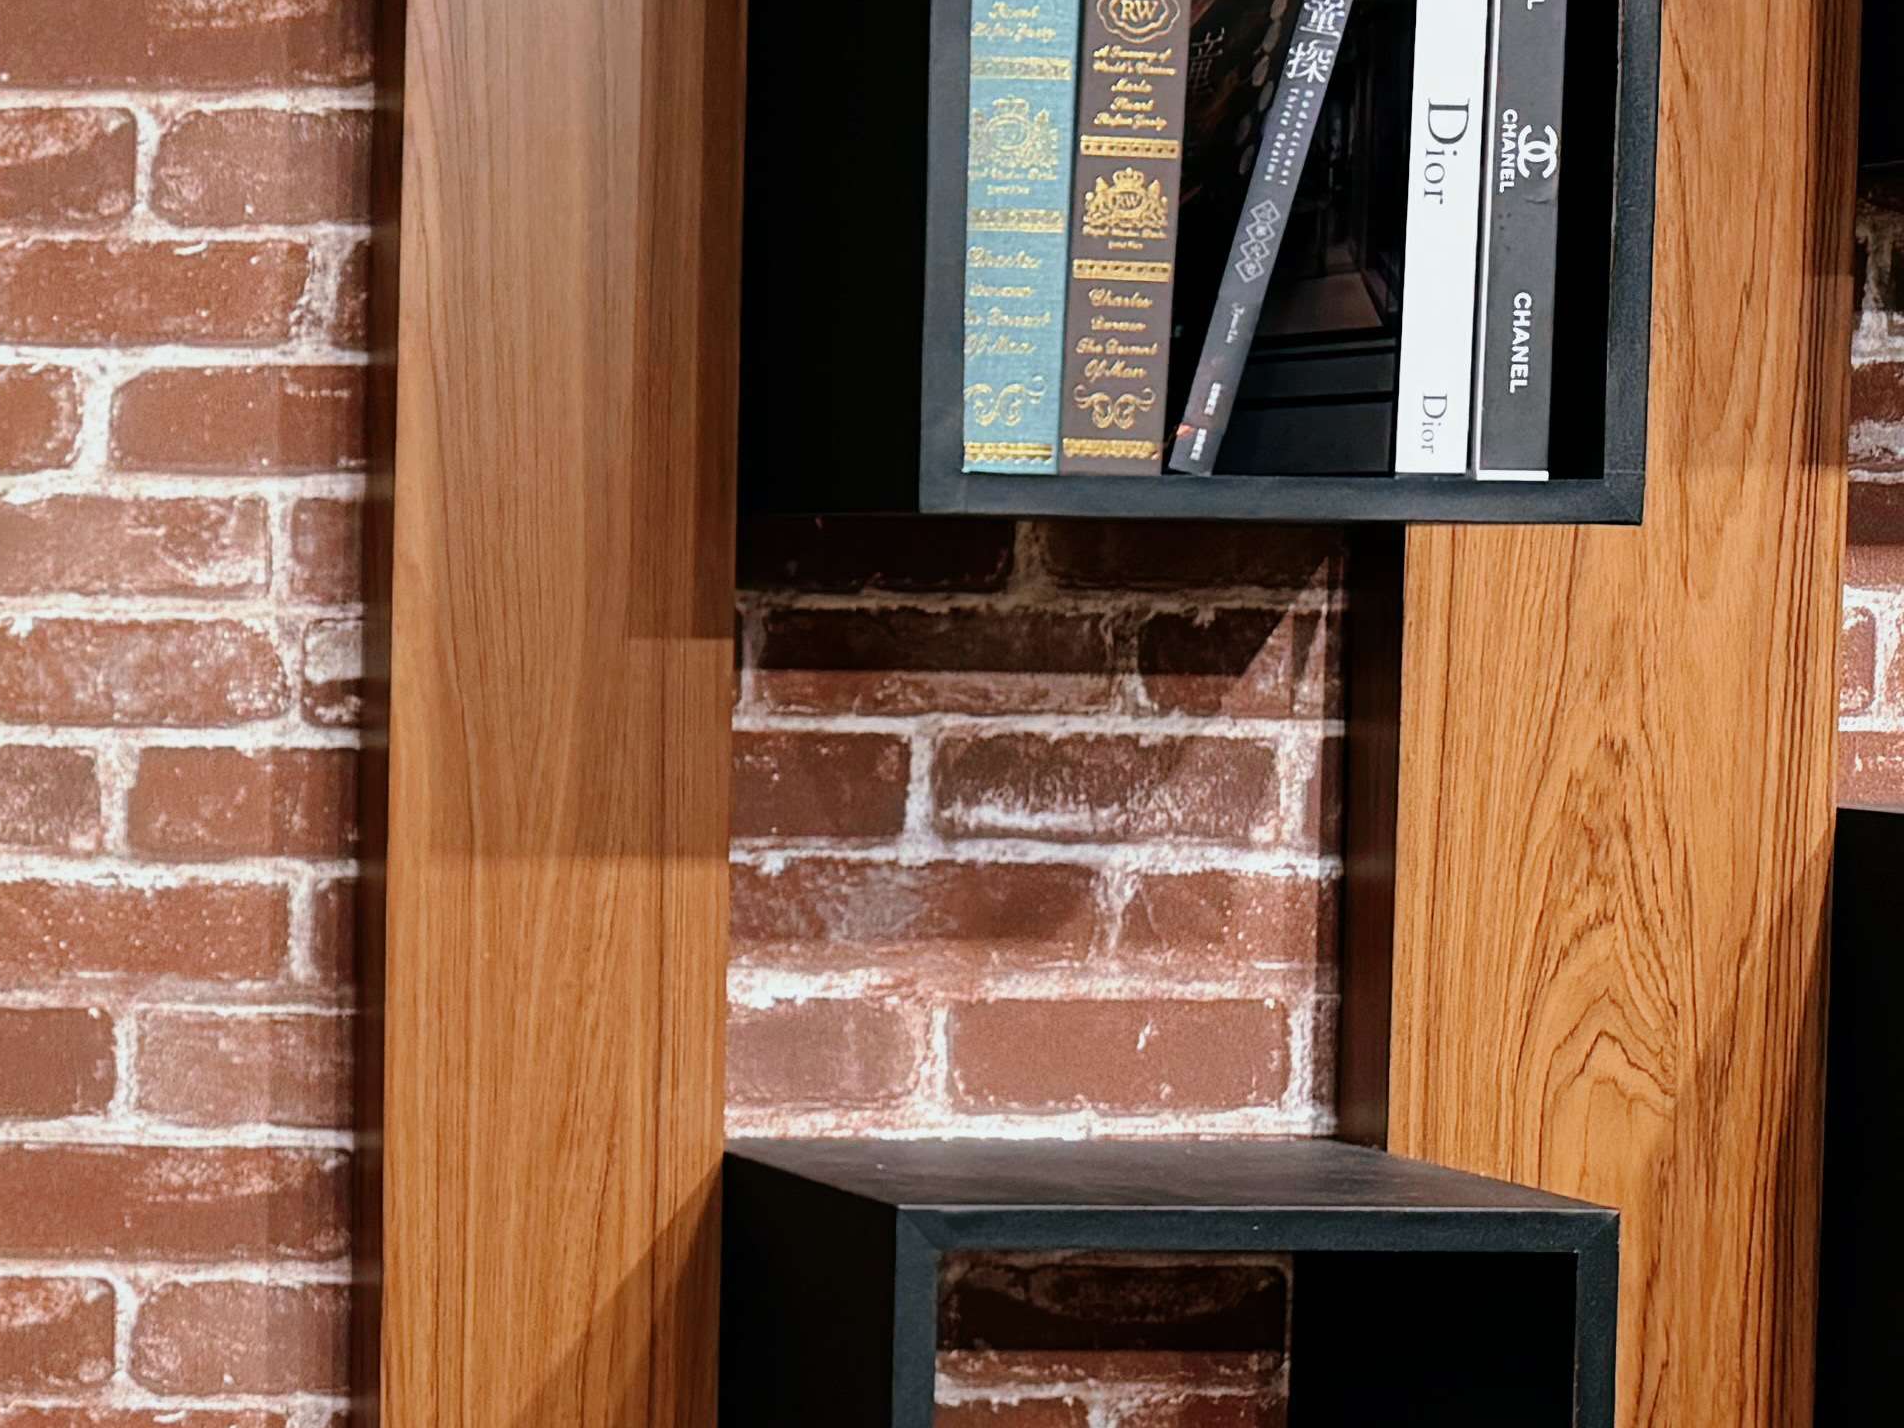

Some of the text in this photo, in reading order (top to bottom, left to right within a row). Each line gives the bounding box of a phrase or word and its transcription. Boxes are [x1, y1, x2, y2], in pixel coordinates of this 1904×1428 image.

[1120, 0, 1158, 22] RW
[1423, 97, 1471, 205] Dior
[1497, 108, 1519, 193] CHANEL
[1088, 288, 1153, 309] Charles
[1510, 292, 1532, 393] CHANEL
[1421, 393, 1449, 456] Dior
